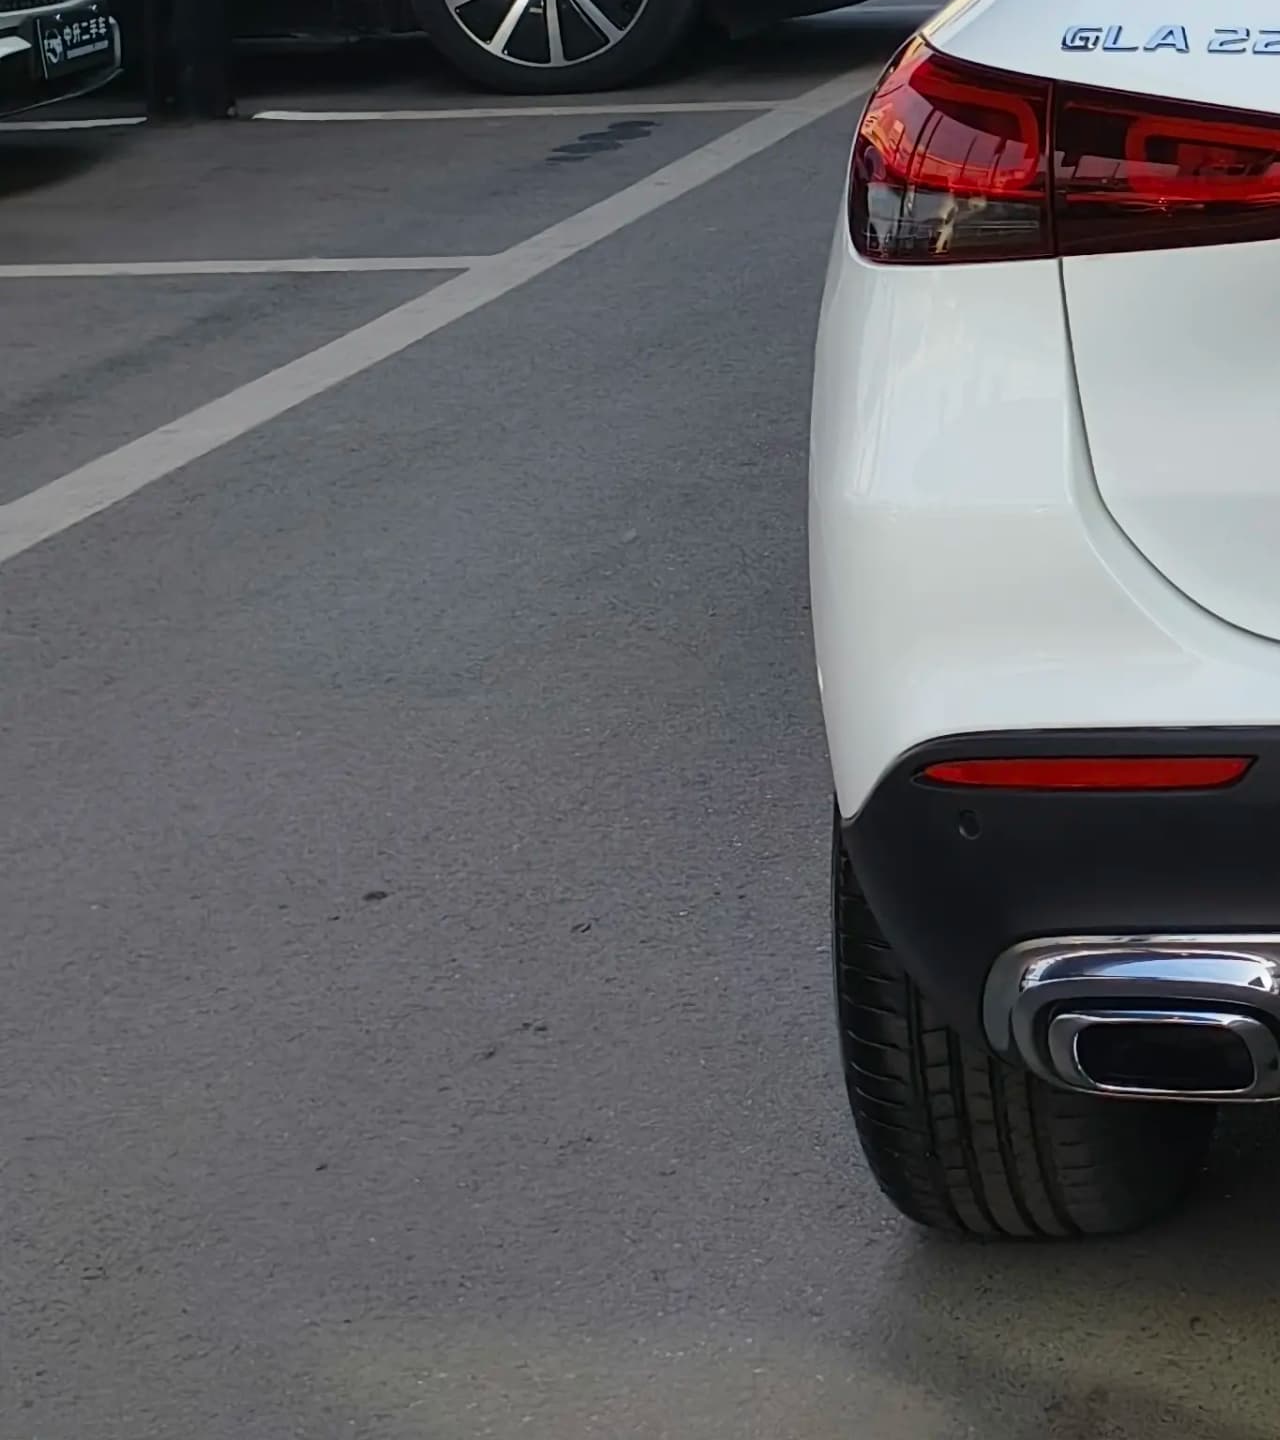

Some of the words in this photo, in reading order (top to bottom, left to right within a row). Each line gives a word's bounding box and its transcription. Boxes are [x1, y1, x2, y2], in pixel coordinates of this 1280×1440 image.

[63, 16, 107, 46] 中升二手车
[1061, 25, 1190, 54] GLA
